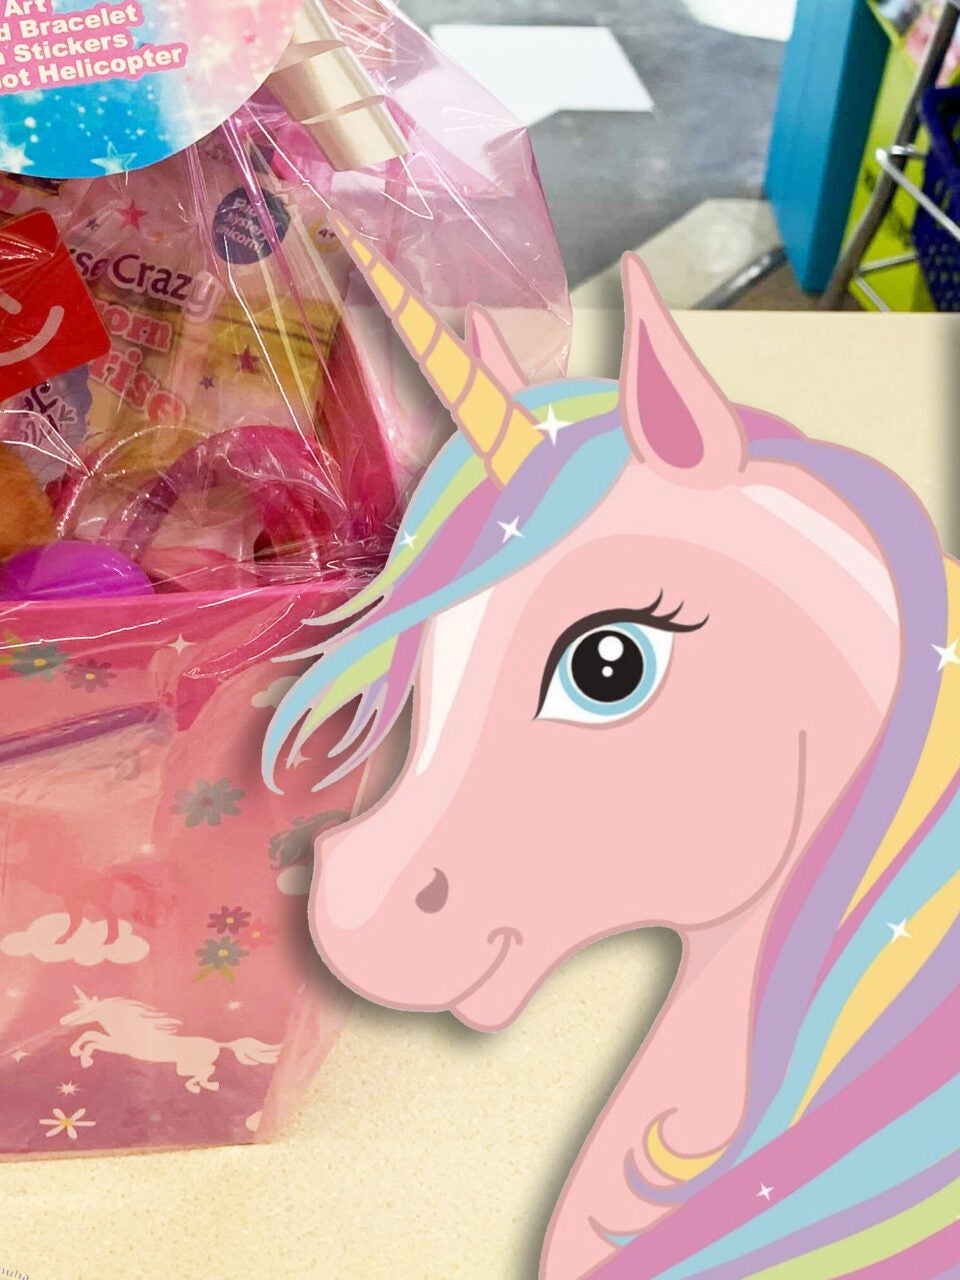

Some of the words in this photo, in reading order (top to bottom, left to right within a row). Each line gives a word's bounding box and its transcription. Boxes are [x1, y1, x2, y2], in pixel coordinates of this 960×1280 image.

[19, 3, 139, 40] Bracelet
[13, 30, 129, 63] Stickers
[37, 46, 183, 85] Helicopter
